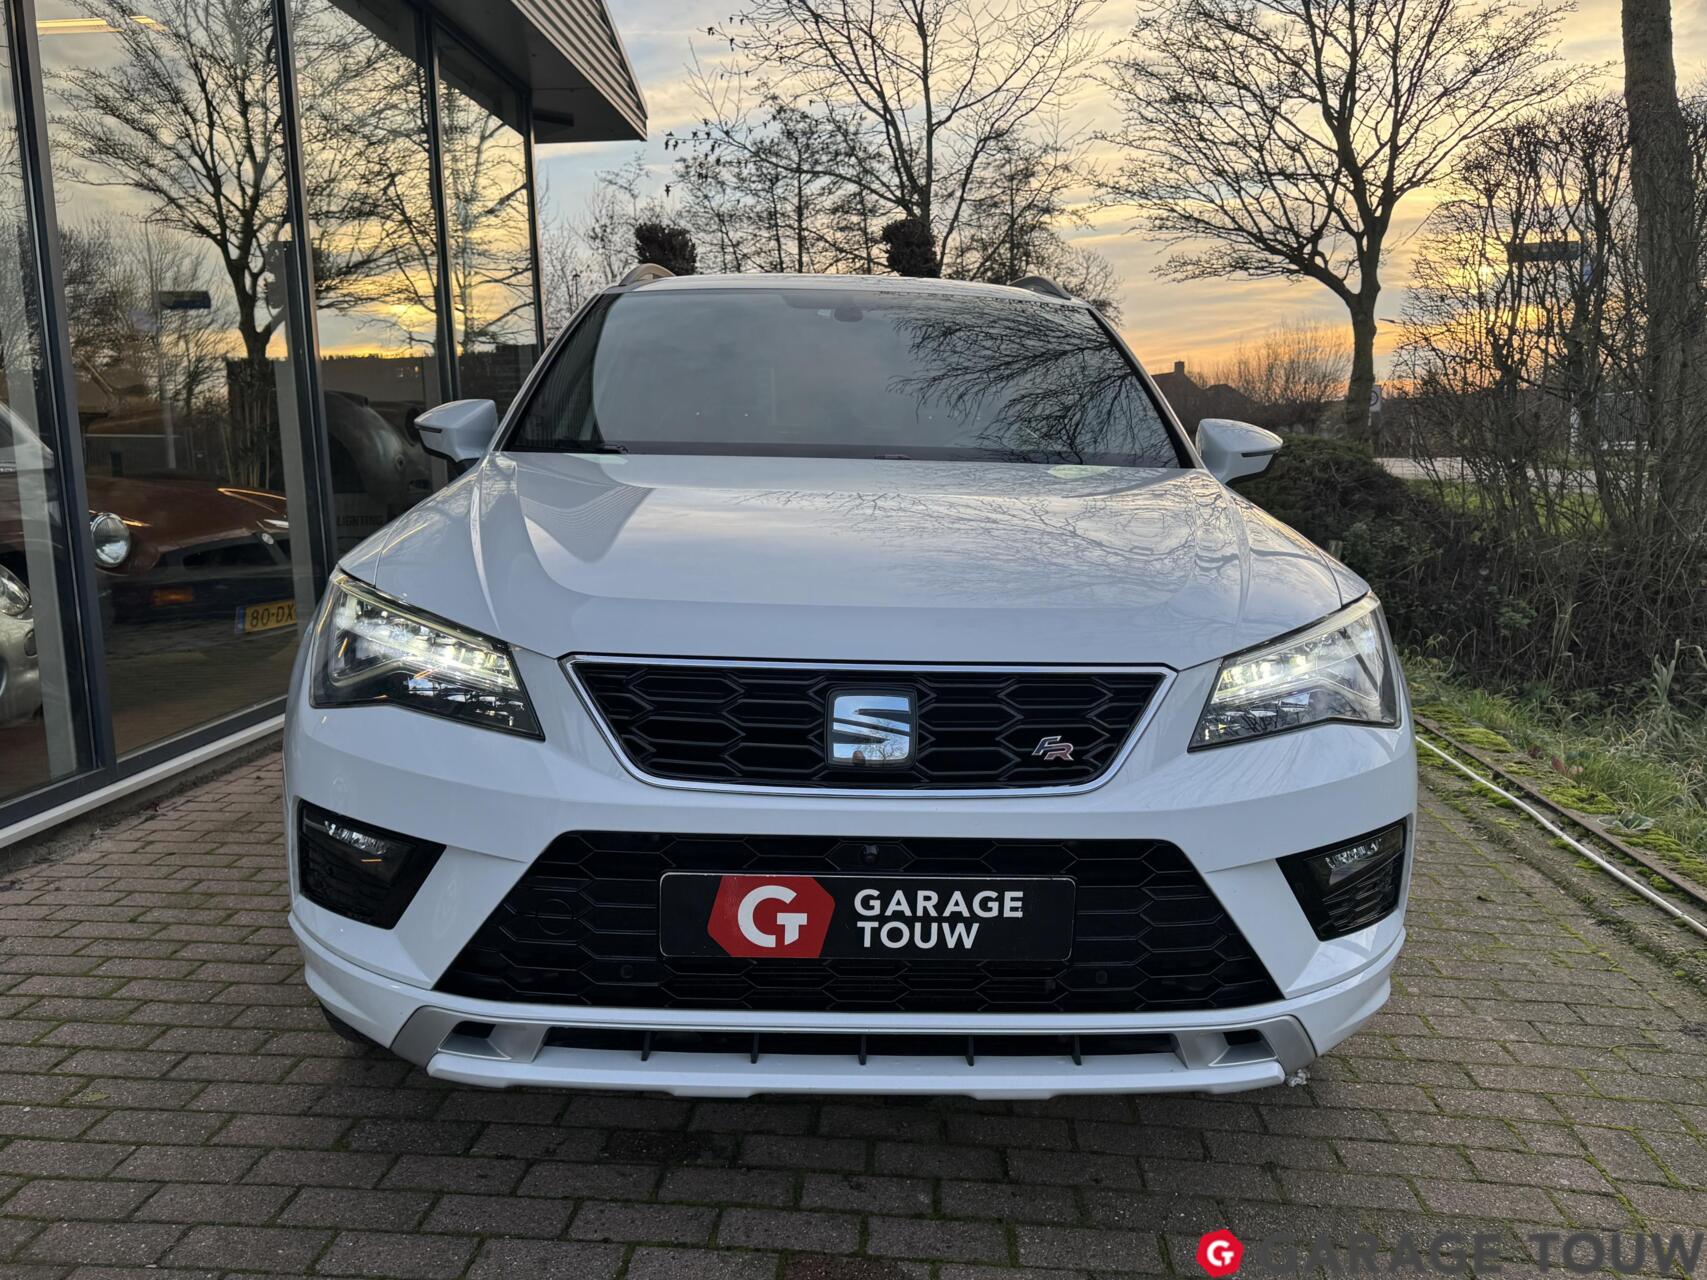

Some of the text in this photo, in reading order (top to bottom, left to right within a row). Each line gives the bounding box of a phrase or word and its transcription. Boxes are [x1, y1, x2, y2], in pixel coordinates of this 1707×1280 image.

[1031, 735, 1074, 761] FR
[854, 888, 1024, 918] GARAGE
[856, 921, 980, 949] TOUW
